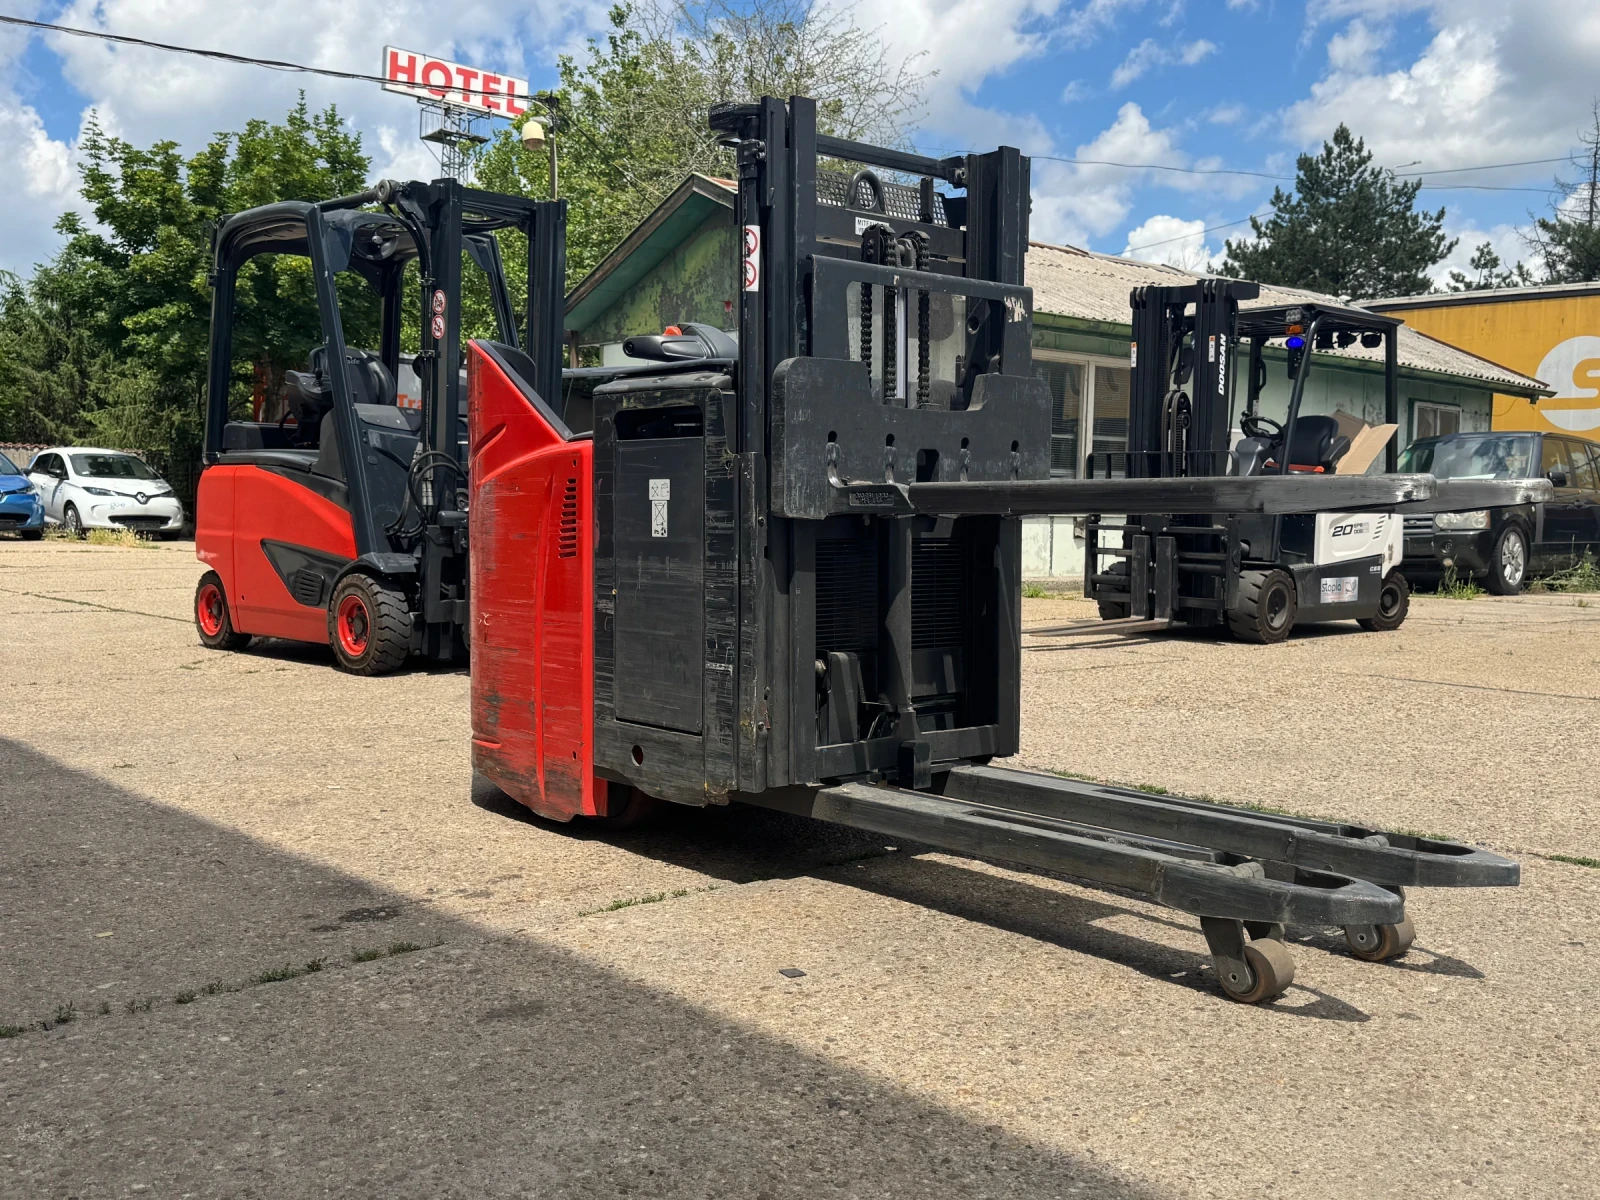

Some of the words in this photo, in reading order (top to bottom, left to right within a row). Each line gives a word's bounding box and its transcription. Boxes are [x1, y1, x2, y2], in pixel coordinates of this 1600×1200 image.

[390, 50, 525, 116] HOTEL
[1218, 333, 1227, 396] DOOSAN
[1332, 523, 1354, 537] 20
